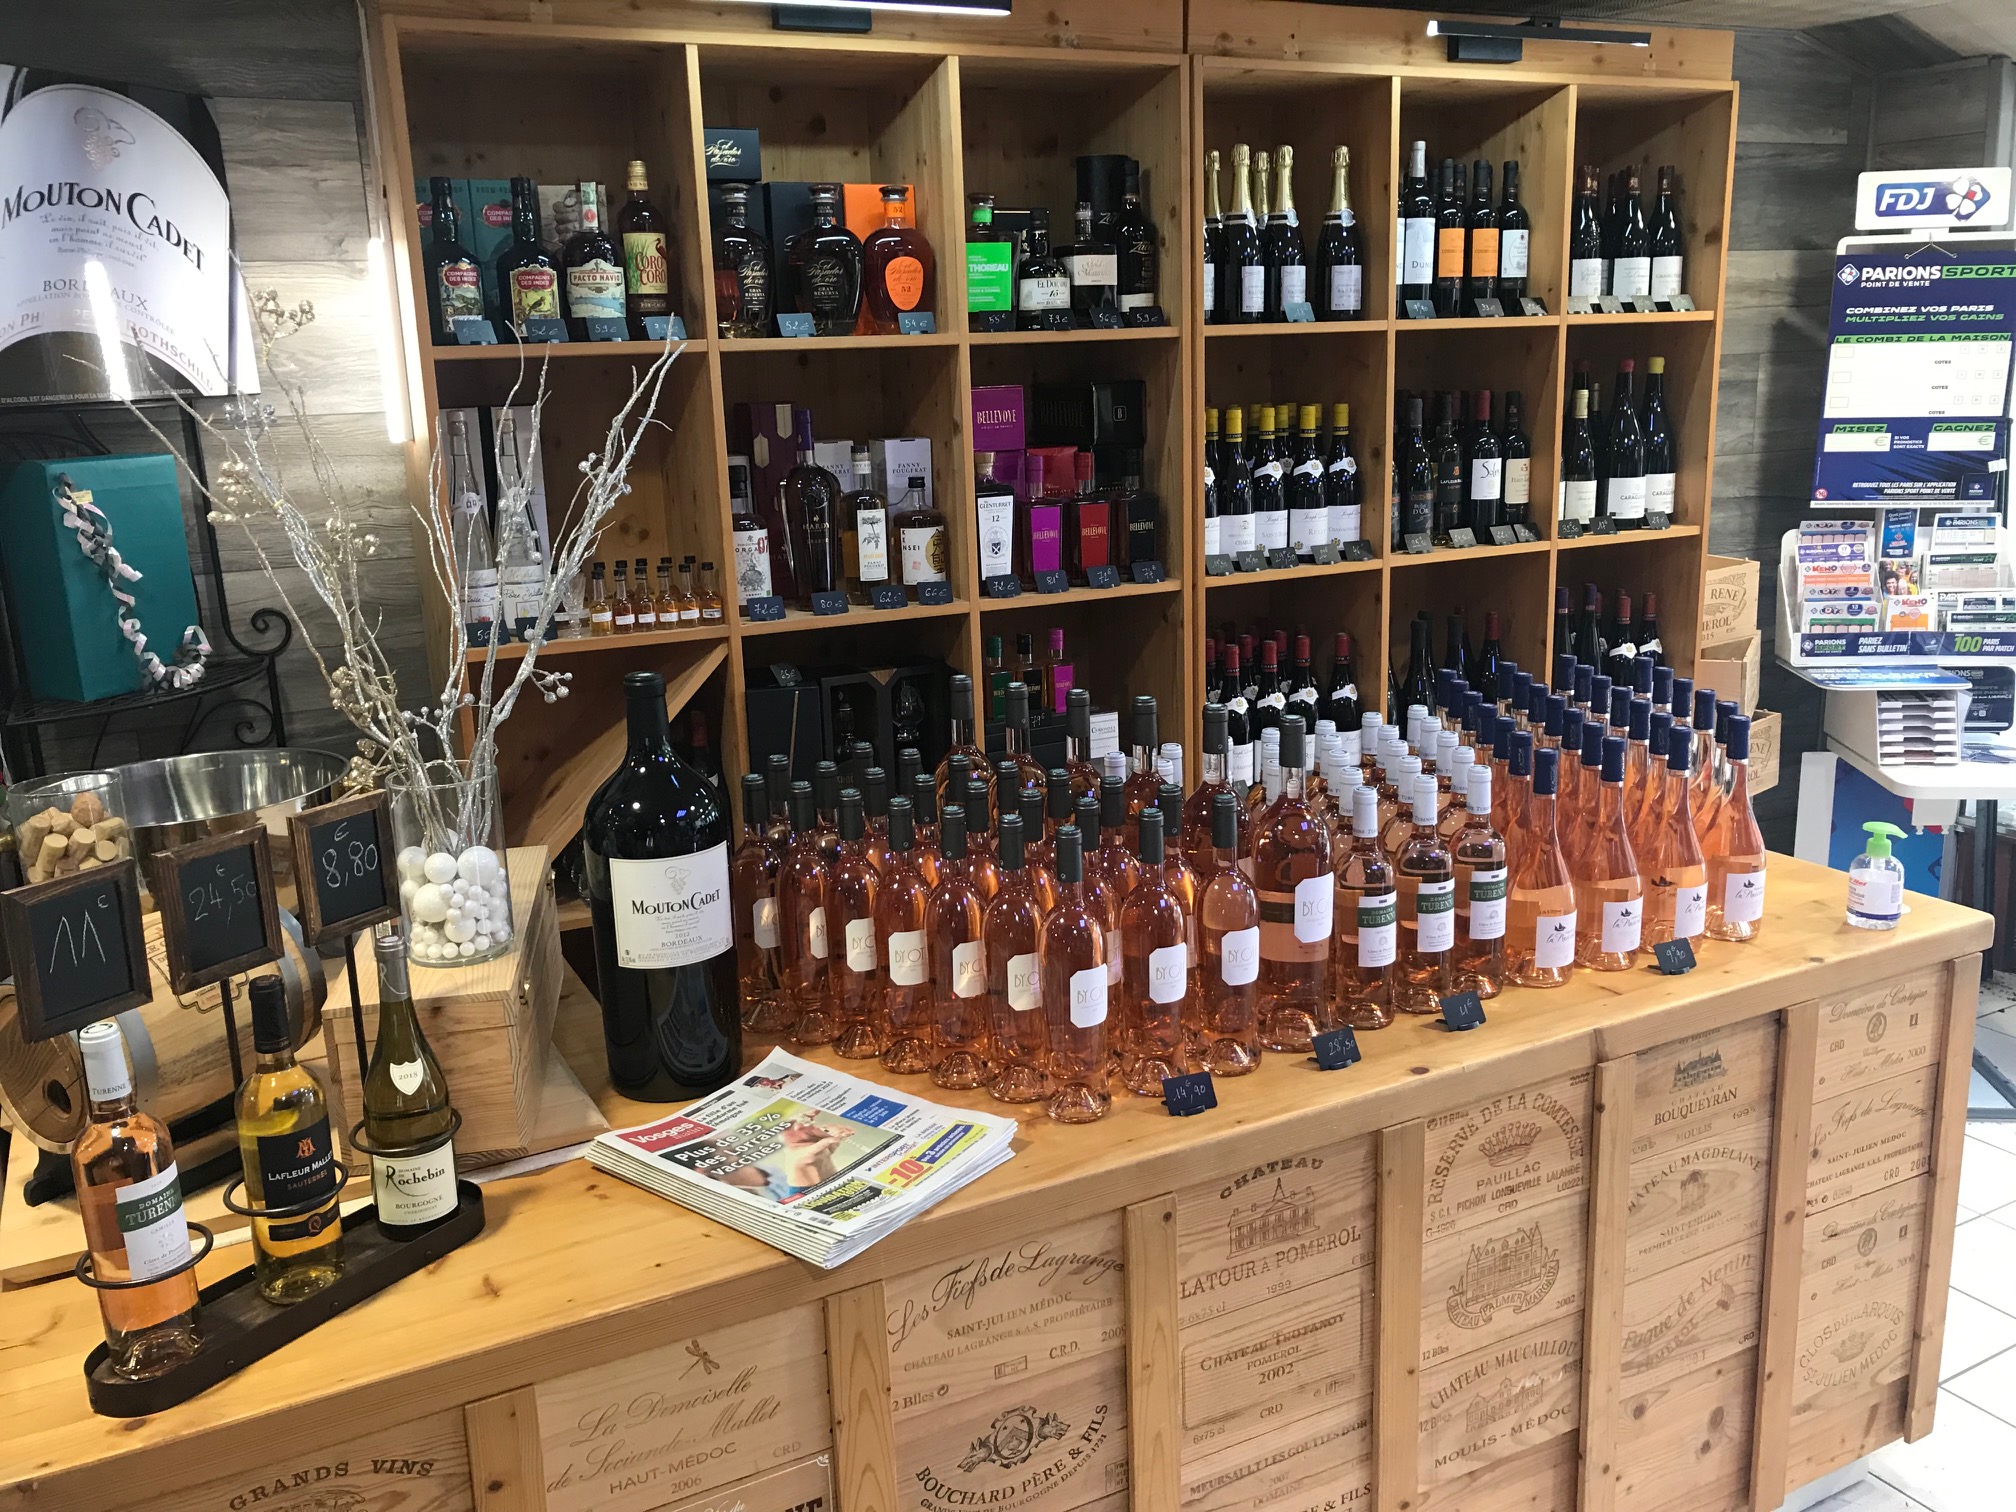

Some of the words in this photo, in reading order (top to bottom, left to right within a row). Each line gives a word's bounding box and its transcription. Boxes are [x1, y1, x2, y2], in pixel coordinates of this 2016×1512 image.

[1879, 187, 1936, 211] FDJ
[1, 182, 122, 229] MOUTON
[127, 192, 205, 272] CADET
[635, 251, 662, 271] CORO
[968, 264, 1009, 272] THOREAU
[573, 274, 598, 282] PACTO
[640, 269, 666, 285] CORO
[1861, 266, 1942, 281] PARIONS
[1945, 266, 2016, 277] SPORT
[1845, 315, 1926, 323] MULTIPLIEZ
[1846, 306, 1917, 314] COMBINEZ
[977, 410, 1017, 424] BELLEVOYE
[1933, 424, 1994, 432] GAGNEZ
[979, 501, 1011, 509] GLENTURRET
[1033, 530, 1059, 540] BELLEVOYE
[1082, 526, 1107, 536] BELLEVOYE
[1129, 522, 1154, 531] BELLEVOYE
[1858, 645, 1876, 653] SANS
[1954, 636, 1983, 652] 100
[631, 898, 690, 915] MOUTON
[690, 888, 721, 910] CADET
[661, 935, 703, 948] BORDEAUX
[1829, 1000, 1873, 1024] Domaine
[1830, 1040, 1844, 1053] CRD
[1907, 1046, 1926, 1061] 2000
[398, 1071, 418, 1080] 2018
[92, 1083, 126, 1096] TURENNE
[1654, 1087, 1738, 1126] BOUQUEYRAN
[1874, 1087, 1928, 1117] Lagrange
[629, 1122, 694, 1144] Vosges
[675, 1144, 715, 1162] Plus
[716, 1134, 739, 1147] de
[737, 1123, 762, 1137] 35
[760, 1112, 781, 1122] %
[1676, 1123, 1712, 1142] MOULIS
[695, 1153, 725, 1169] des
[727, 1121, 791, 1155] Lorrains
[1427, 1117, 1480, 1207] RESERVE
[1480, 1098, 1503, 1124] DE
[1506, 1092, 1527, 1112] LA
[1532, 1093, 1584, 1161] COMTESSE
[268, 1166, 310, 1181] LAFLEUR
[312, 1151, 333, 1171] MALLET
[711, 1142, 783, 1176] vaccinés
[1680, 1147, 1761, 1173] MAGDELAINE
[385, 1165, 445, 1189] Rochebin
[1218, 1157, 1324, 1200] CHATEAU
[1476, 1161, 1541, 1190] PAUILLAC
[1834, 1164, 1865, 1180] LAGRANGE
[1884, 1167, 1900, 1181] CRD
[1456, 1194, 1486, 1212] PICHON
[1491, 1176, 1541, 1201] LONGUEVILLE
[1546, 1165, 1581, 1183] LALANDE
[395, 1195, 444, 1210] BOURGOGNE
[404, 1204, 438, 1215] CHARDONNAY
[1498, 1199, 1518, 1213] CRD
[144, 1255, 160, 1266] Côtes
[1180, 1260, 1257, 1300] LATOUR
[1275, 1225, 1362, 1269] POMEROL
[1821, 1256, 1837, 1269] CRD
[1266, 1280, 1292, 1295] 1999
[1677, 1291, 1695, 1313] de
[1701, 1253, 1752, 1292] Nenin
[886, 1299, 929, 1353] Les
[931, 1257, 990, 1311] Fiefs
[990, 1251, 1015, 1281] de
[1017, 1241, 1125, 1287] Lagrange
[1482, 1293, 1524, 1317] PALMER
[1555, 1295, 1575, 1310] 2002
[946, 1306, 1028, 1340] SAINT-JULIEN
[1029, 1291, 1073, 1316] MÉDOC
[957, 1329, 1013, 1355] LAGRANGE
[1043, 1296, 1113, 1327] PROPRIÉTAIRE
[1049, 1341, 1080, 1360] C.R.D.
[1799, 1325, 1832, 1370] CLOS
[1833, 1315, 1850, 1333] DU
[1246, 1346, 1302, 1370] POMEROL
[1422, 1350, 1431, 1361] 12
[1816, 1366, 1857, 1388] JULIEN
[1859, 1329, 1898, 1372] MEDOC
[1258, 1363, 1294, 1385] 2002
[1430, 1361, 1489, 1410] CHATEAU
[1494, 1340, 1578, 1371] MAUCAILLOU
[569, 1402, 620, 1448] La
[624, 1364, 758, 1429] Demoiselle
[1259, 1403, 1284, 1419] CRD
[1434, 1434, 1498, 1469] MOULIS
[1510, 1404, 1571, 1437] MÉDOC
[772, 1441, 801, 1458] CRD
[915, 1466, 1015, 1506] BOUCHARD
[1022, 1458, 1067, 1492] PÈRE
[1068, 1447, 1083, 1460] &
[1081, 1404, 1108, 1443] FILS
[609, 1441, 737, 1494] HAUT-MÉDOC
[1060, 1454, 1090, 1483] DEPUIS
[1189, 1460, 1263, 1496] MEURSAULT
[1264, 1450, 1287, 1470] LES
[229, 1461, 349, 1512] GRANDS
[370, 1459, 434, 1477] VINS
[546, 1464, 574, 1494] de
[671, 1476, 702, 1494] 2006
[1340, 1482, 1372, 1507] FILS
